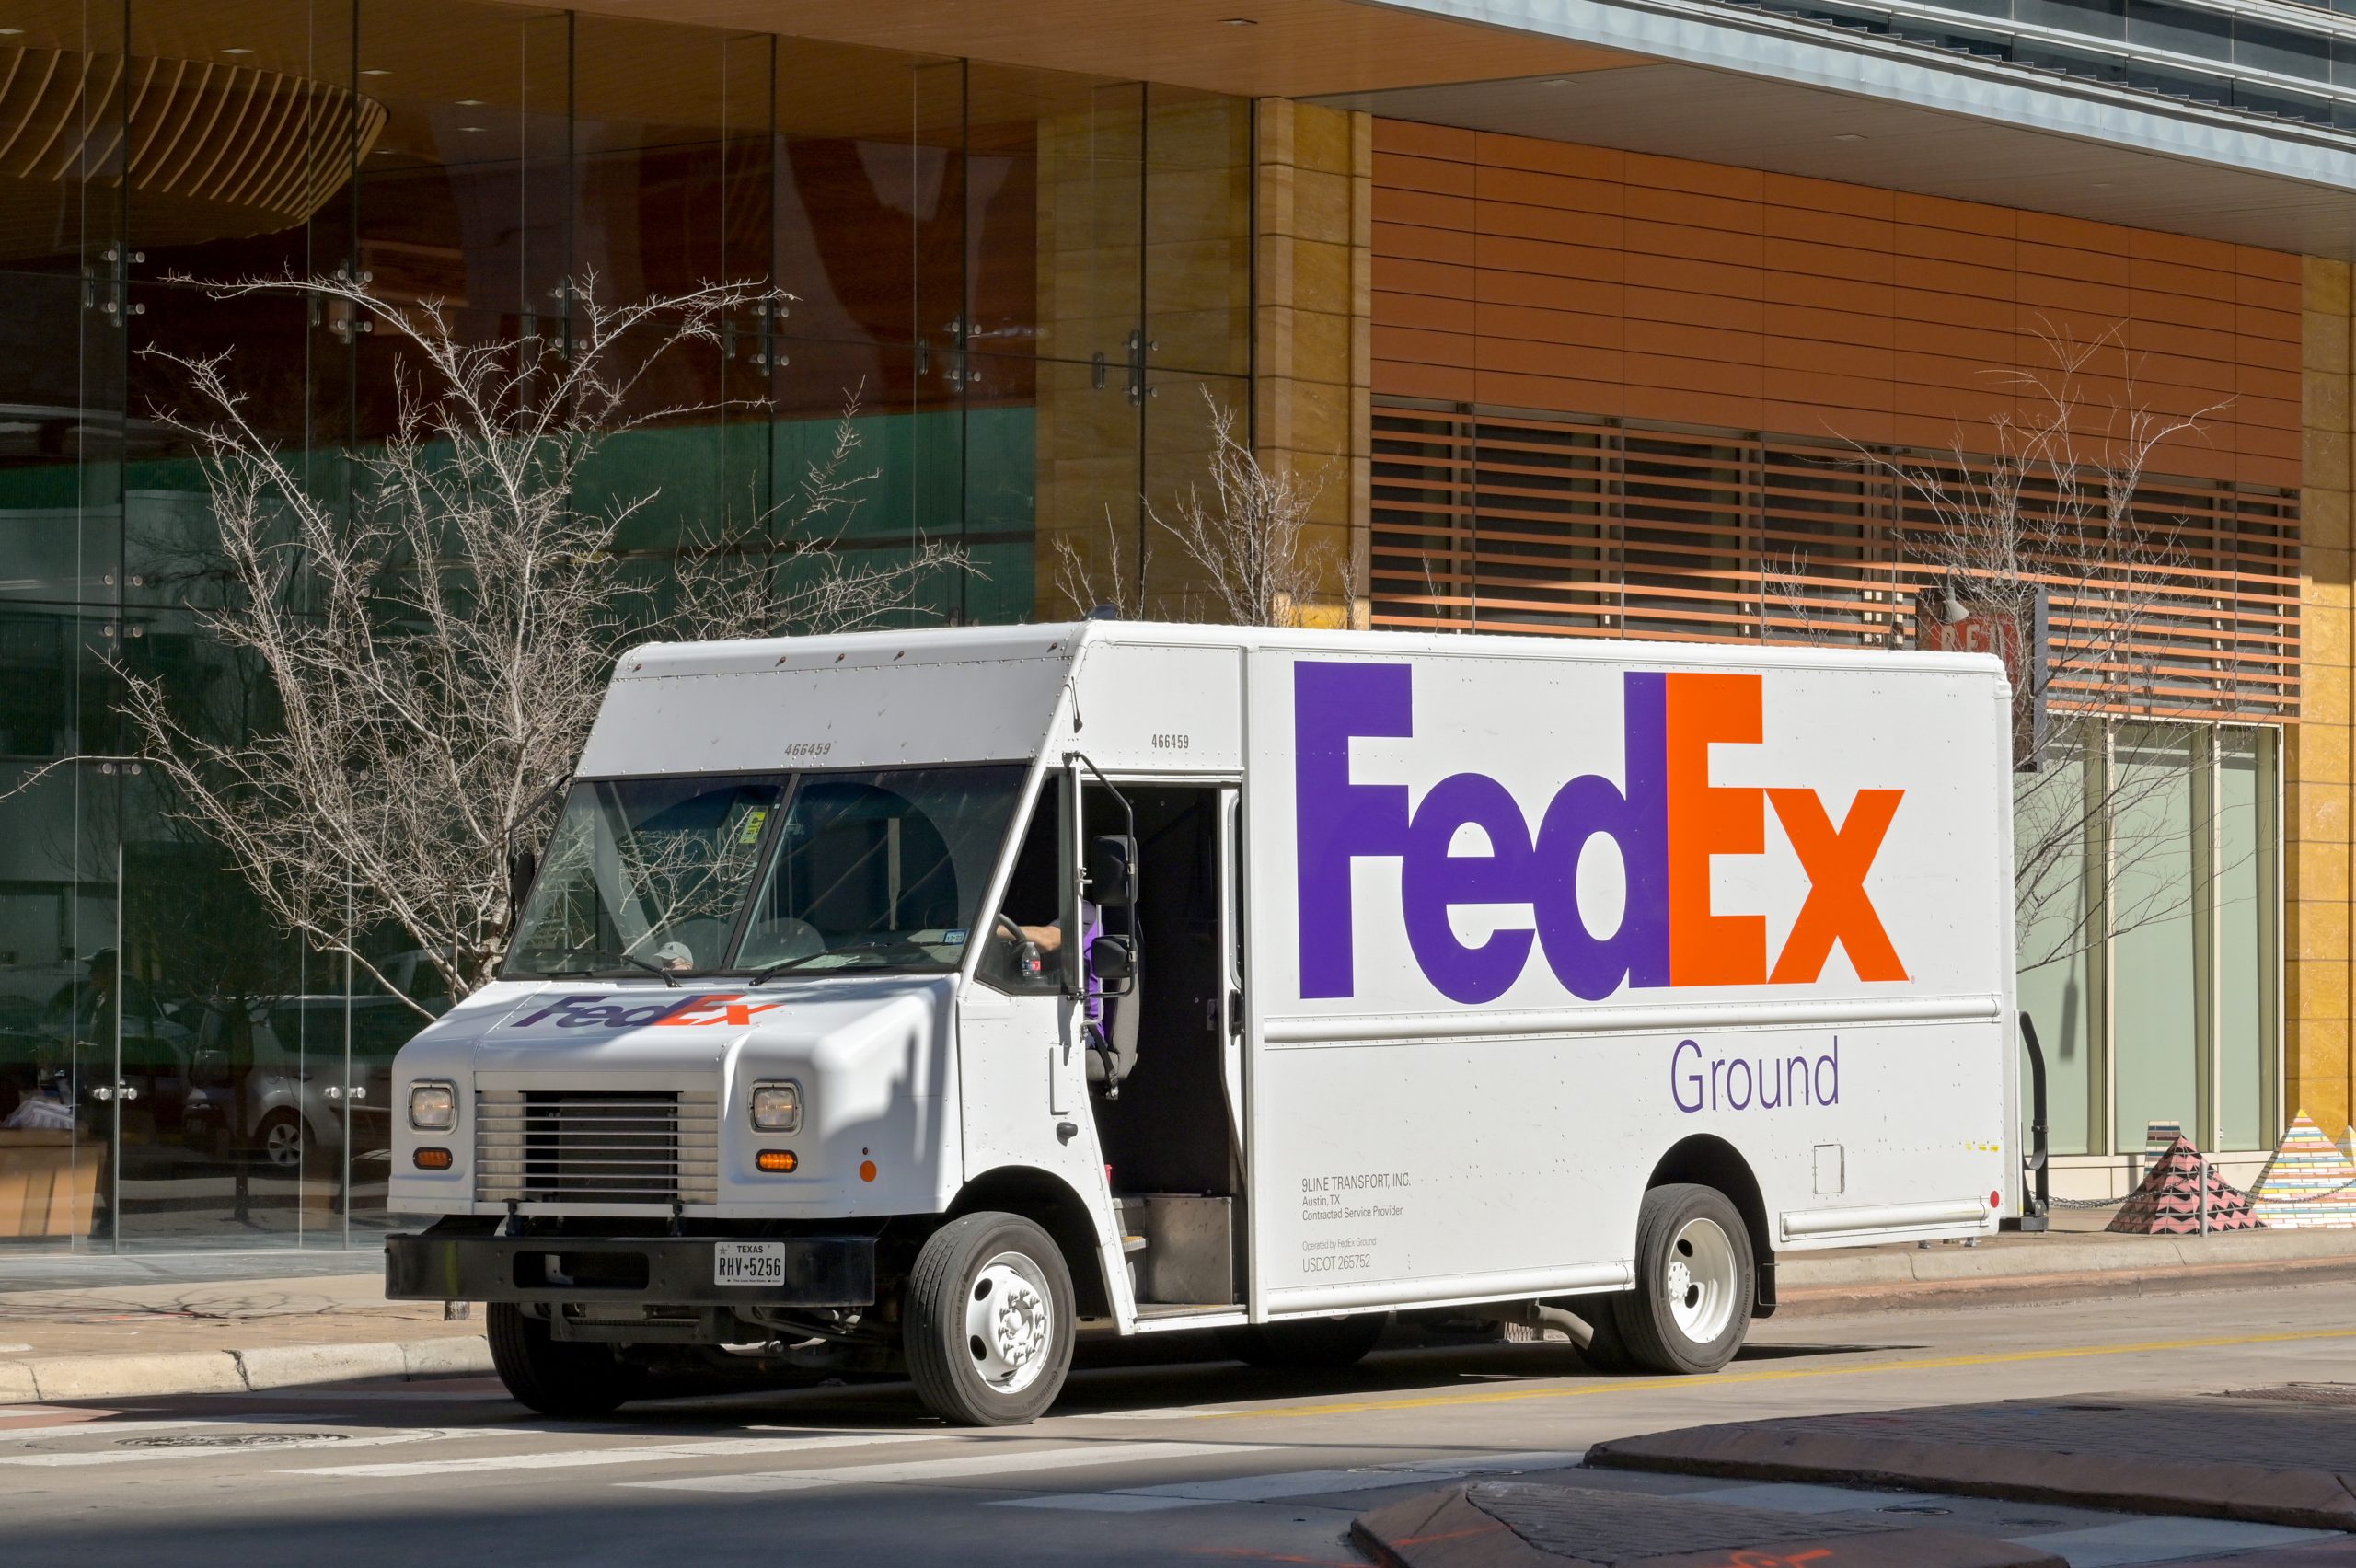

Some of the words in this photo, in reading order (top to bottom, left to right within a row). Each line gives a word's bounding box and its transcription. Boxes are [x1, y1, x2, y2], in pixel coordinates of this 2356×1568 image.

[1151, 733, 1189, 749] 466459
[784, 743, 832, 756] 466459
[1294, 661, 1910, 1004] FedEx
[510, 994, 788, 1028] FedEx
[1670, 1035, 1840, 1113] Ground
[1301, 1177, 1329, 1193] 9LINE
[1331, 1173, 1390, 1191] TRANSPORT,
[1392, 1172, 1412, 1187] INC.
[1302, 1195, 1329, 1207] Austin,
[1330, 1194, 1340, 1205] TX
[1302, 1208, 1343, 1221] Contracted
[1344, 1207, 1371, 1218] Service
[1373, 1205, 1403, 1217] Provider
[736, 1245, 764, 1253] TEXAS
[1302, 1239, 1329, 1252] Operated
[1329, 1239, 1336, 1250] by
[1337, 1238, 1355, 1249] FedEx
[1356, 1237, 1377, 1247] Ground
[1302, 1255, 1335, 1273] USDOT
[1338, 1253, 1370, 1270] 265752
